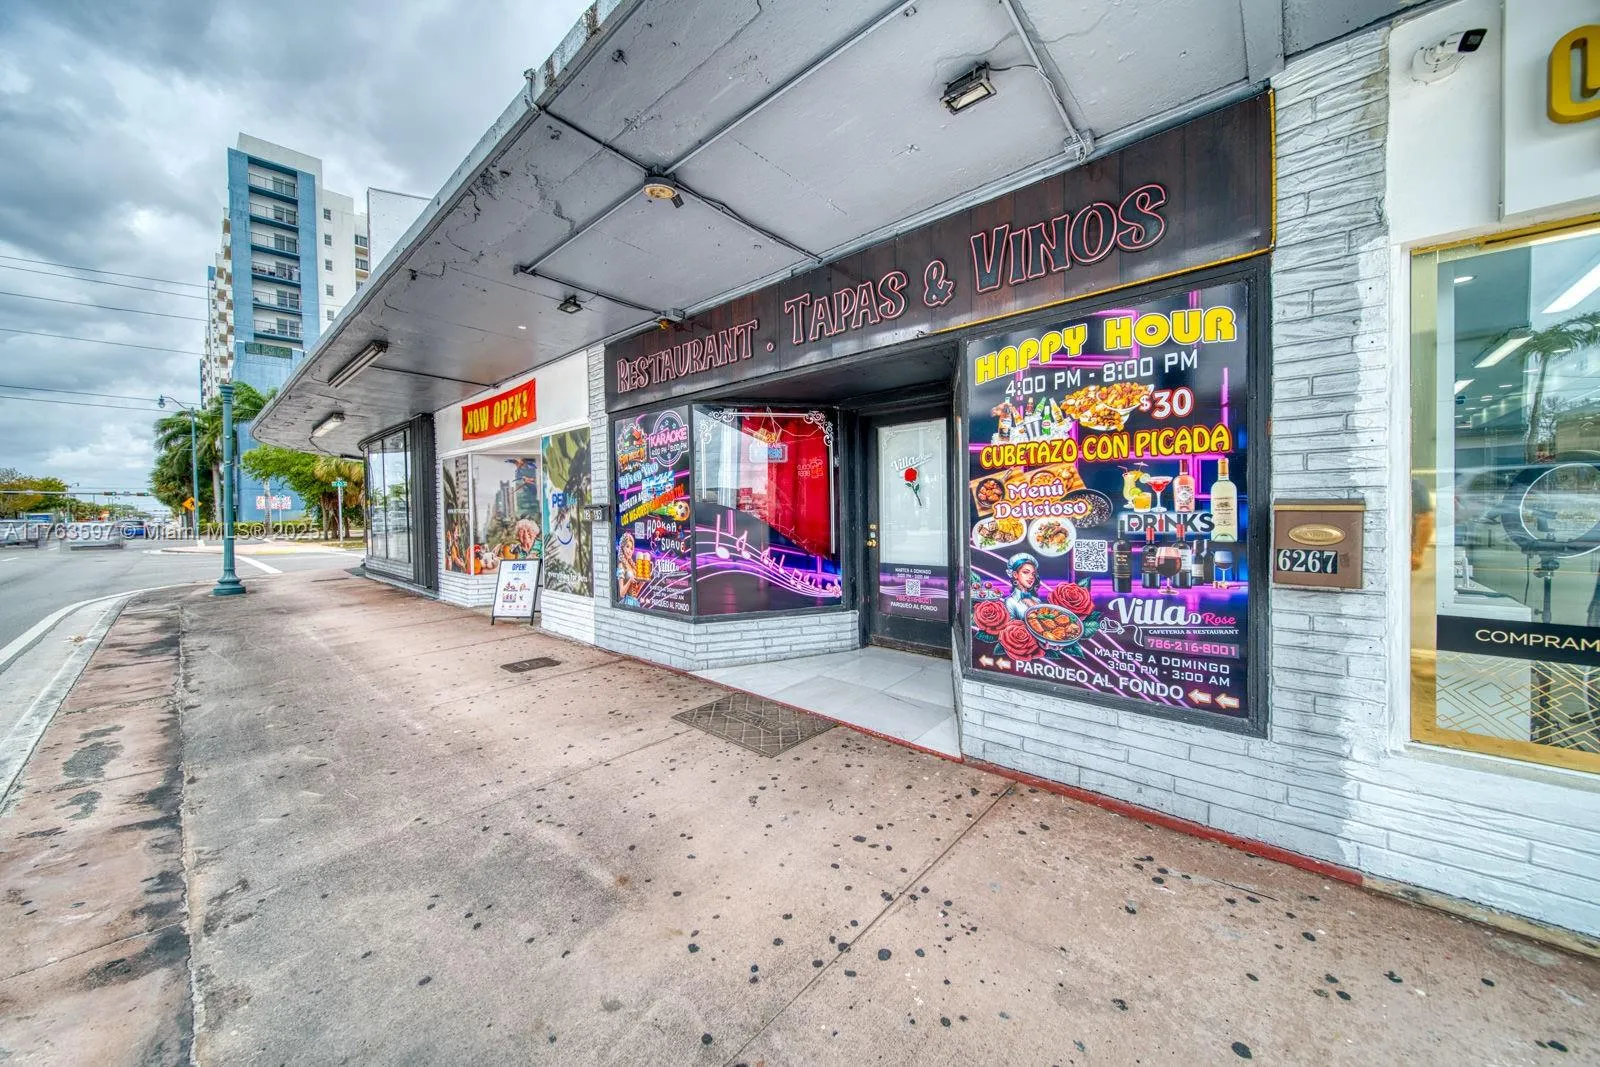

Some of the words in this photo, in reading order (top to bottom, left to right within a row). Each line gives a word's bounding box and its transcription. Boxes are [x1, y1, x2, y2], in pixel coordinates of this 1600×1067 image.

[616, 319, 758, 394] RESTAURANT
[784, 270, 908, 345] TAPAS
[923, 260, 954, 308] &
[969, 183, 1168, 293] VINOS
[974, 323, 1088, 385] HAPPY
[1103, 306, 1238, 351] HOUR
[1005, 376, 1046, 398] 4:00
[1054, 369, 1081, 390] PM
[1102, 356, 1154, 383] 8:00
[1164, 349, 1198, 374] PM
[464, 405, 489, 434] NOW
[493, 389, 528, 428] OPEN!
[1138, 386, 1194, 419] $30
[650, 427, 688, 447] KARAOKE
[980, 437, 1078, 469] CUBETAZO
[1082, 433, 1130, 460] CON
[1135, 424, 1233, 457] PICADA
[1007, 478, 1064, 499] Menú
[993, 501, 1088, 519] Delicioso
[1126, 512, 1215, 533] DRINKS
[647, 519, 677, 540] HOOKAH
[661, 537, 685, 553] SUAVE
[1277, 549, 1337, 574] 6267
[675, 602, 690, 612] FONDO
[890, 601, 913, 609] PARQUEO
[920, 604, 938, 612] FONDO
[1108, 597, 1188, 625] Villa
[1201, 612, 1237, 626] Rose
[1147, 638, 1237, 657] 786-216-8001
[1475, 629, 1600, 653] COMPRAM
[1094, 647, 1143, 662] MARTES
[1147, 655, 1157, 664] A
[1161, 656, 1230, 675] DOMINGO
[1015, 659, 1088, 684] PARQUEO
[1092, 674, 1115, 688] AL
[1119, 678, 1184, 700] FONDO
[1107, 660, 1136, 673] 3:00
[1140, 665, 1159, 677] PM
[1171, 669, 1204, 683] 3:00
[1208, 676, 1230, 688] AM
